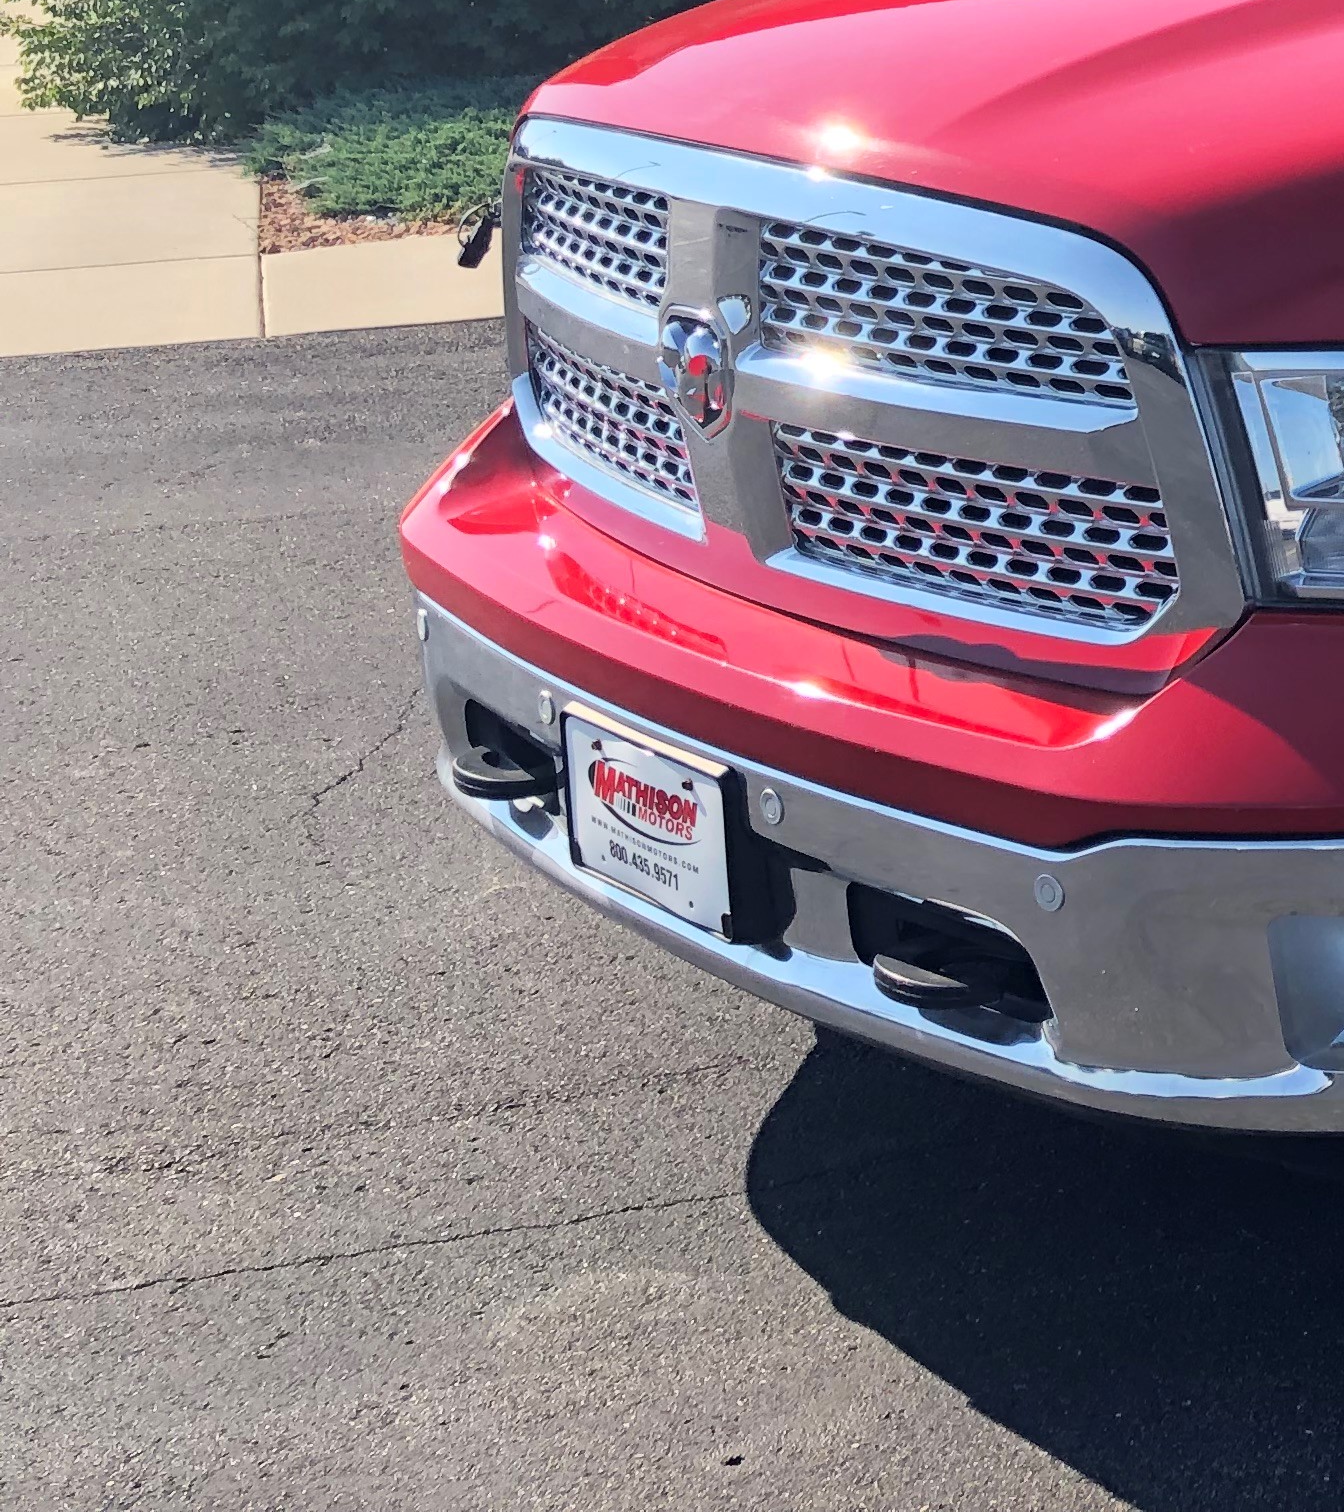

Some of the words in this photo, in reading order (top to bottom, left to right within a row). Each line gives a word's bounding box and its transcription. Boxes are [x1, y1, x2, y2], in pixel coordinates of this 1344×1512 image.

[594, 760, 698, 828] MATHISON
[637, 805, 694, 841] MOTORS
[609, 838, 679, 891] 800.435.9571
